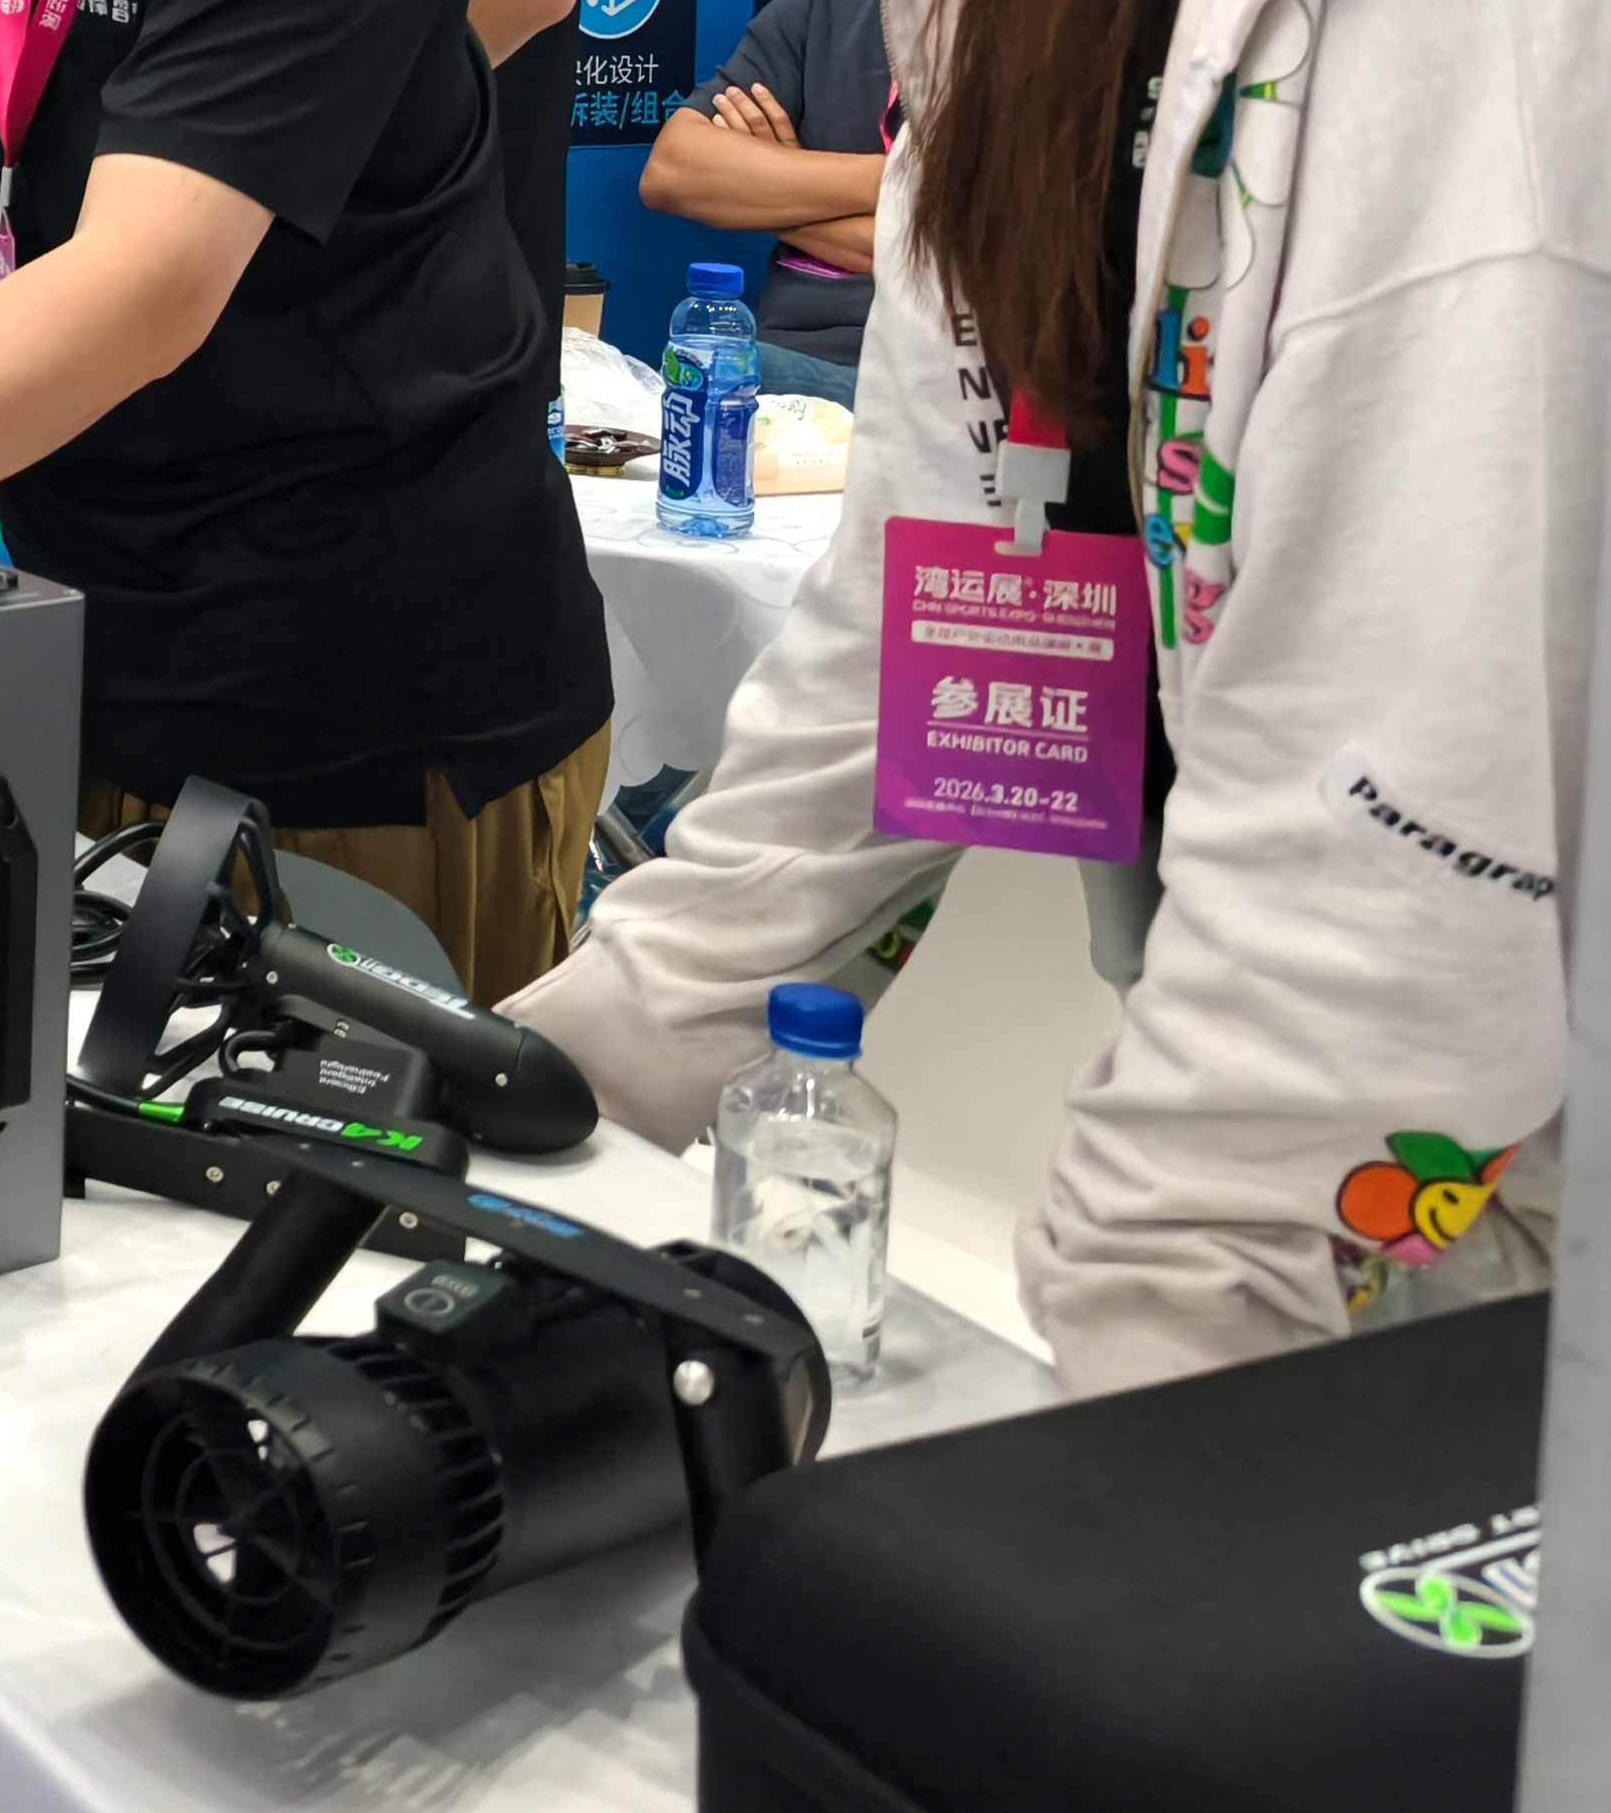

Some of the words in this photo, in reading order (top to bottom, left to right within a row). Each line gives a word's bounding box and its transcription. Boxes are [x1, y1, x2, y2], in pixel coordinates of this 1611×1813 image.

[930, 675, 1090, 734] 参展证
[926, 730, 1029, 758] EXHIBITOR
[1034, 742, 1090, 765] CARD
[933, 776, 1080, 812] 2026.3.20-22
